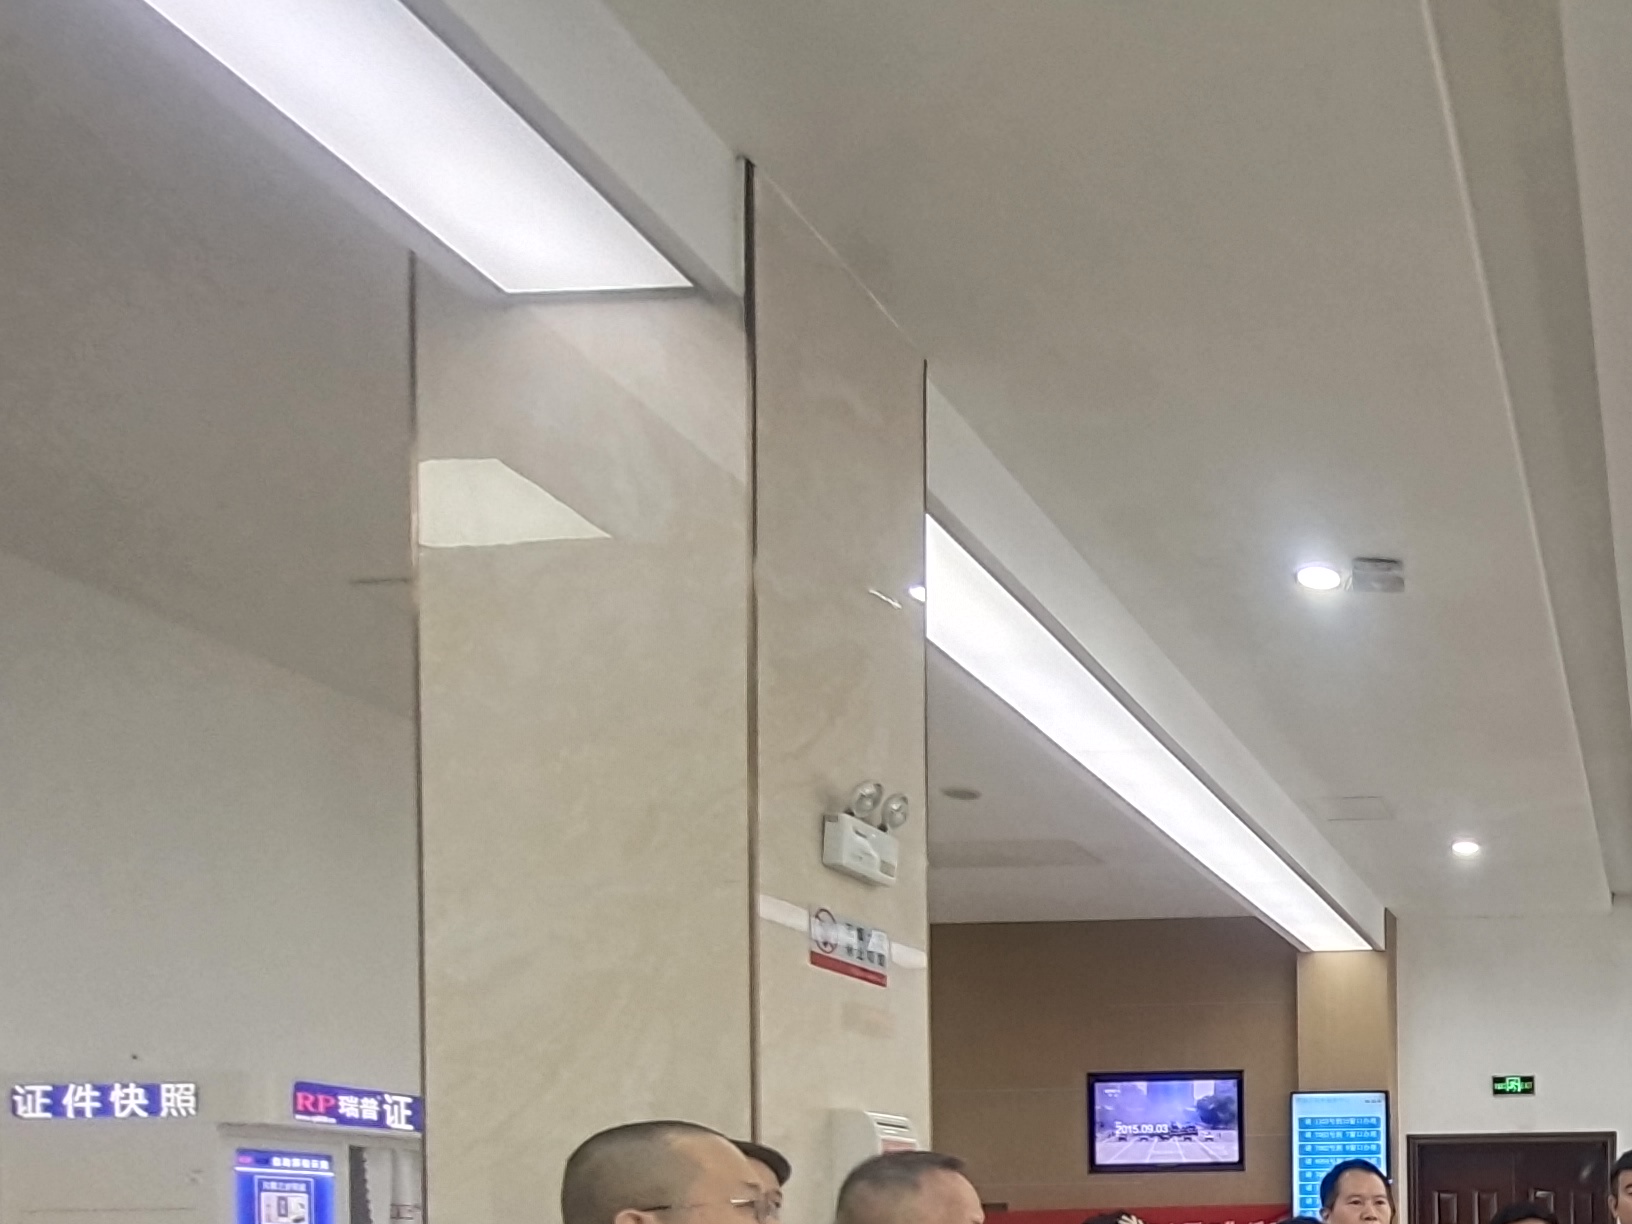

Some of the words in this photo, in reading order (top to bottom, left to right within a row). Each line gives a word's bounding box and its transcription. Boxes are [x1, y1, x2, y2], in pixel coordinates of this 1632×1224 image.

[12, 1082, 197, 1118] 证件快照
[295, 1091, 336, 1114] RP
[337, 1095, 380, 1120] 瑞普
[382, 1093, 414, 1130] 证
[1115, 1123, 1168, 1135] 2015.09.03
